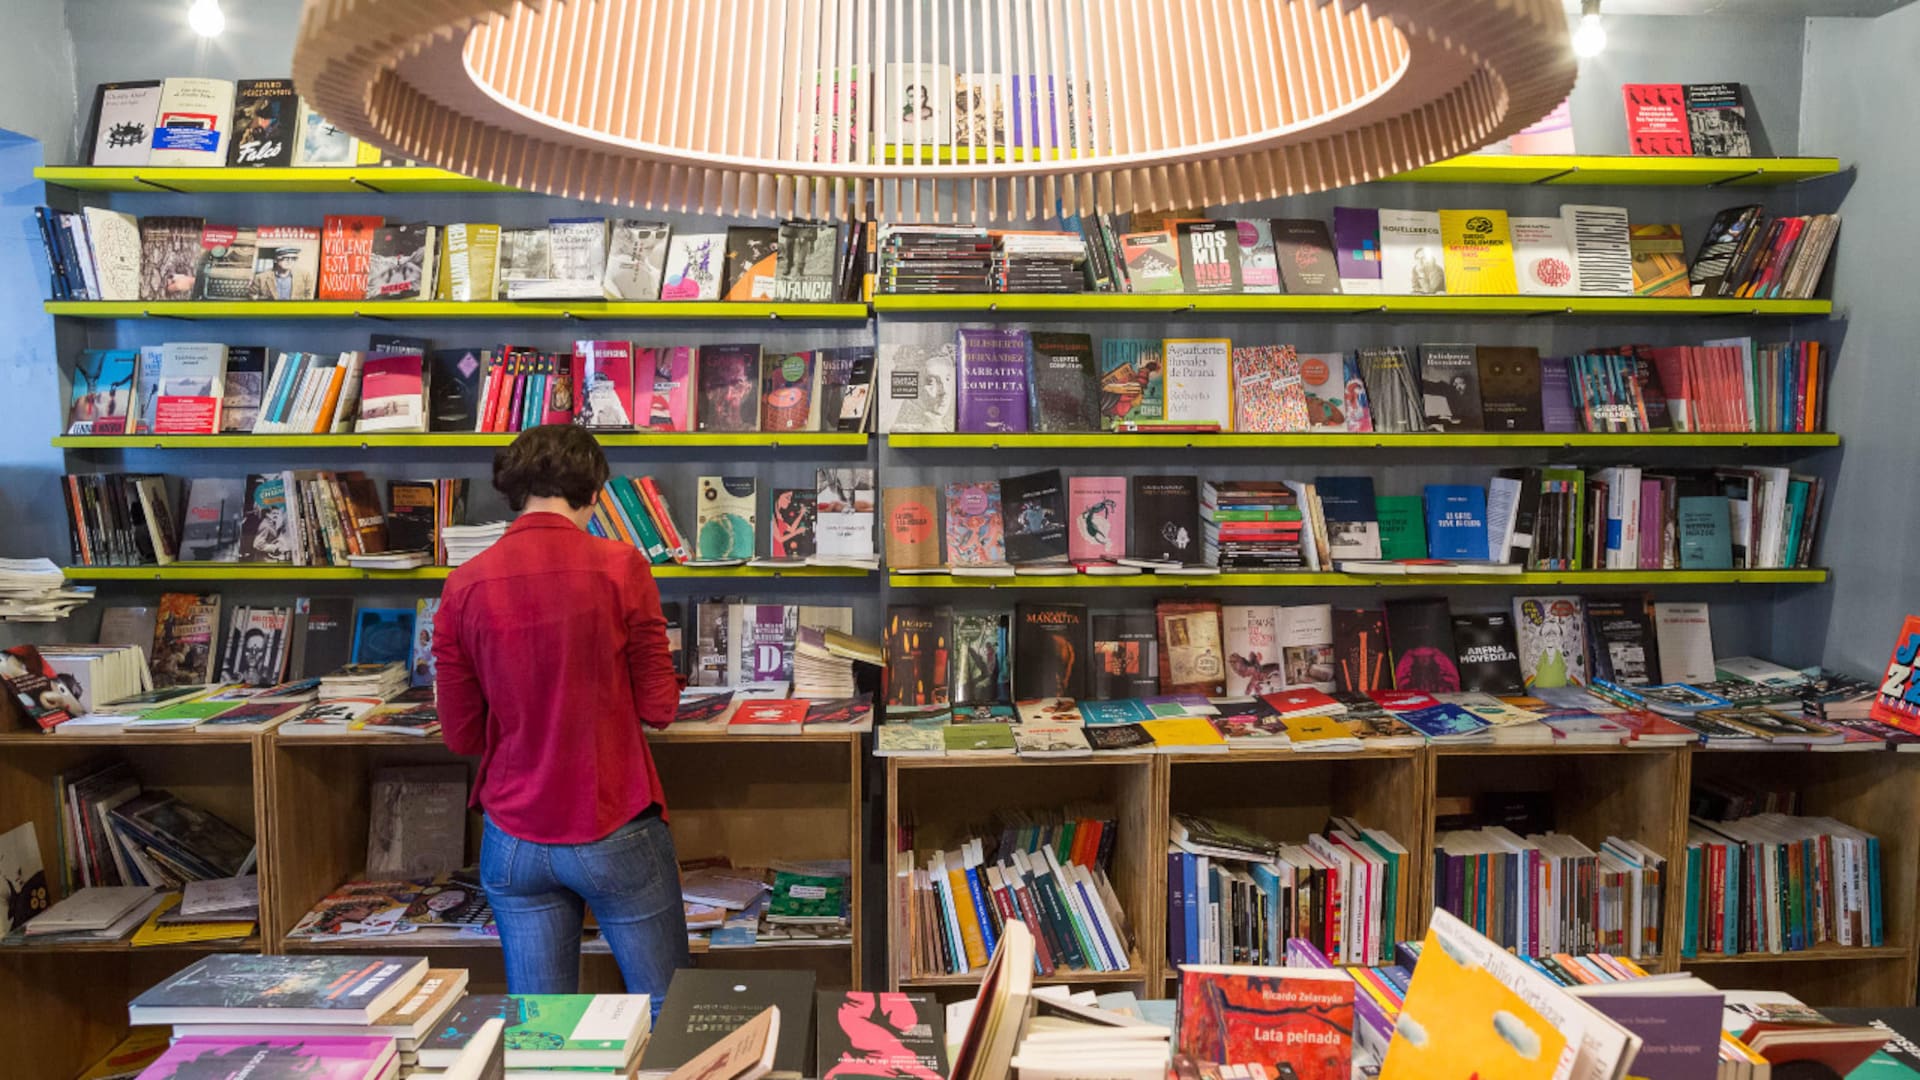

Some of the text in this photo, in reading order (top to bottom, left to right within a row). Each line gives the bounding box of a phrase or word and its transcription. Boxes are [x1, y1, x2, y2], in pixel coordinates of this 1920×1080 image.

[1190, 231, 1227, 249] DOS
[1193, 247, 1229, 264] MIL
[1459, 651, 1517, 664] MOVEDIZA
[1467, 645, 1504, 656] ARENA
[1262, 990, 1343, 1005] Ricardo Zelarayán
[1254, 1027, 1341, 1045] Lata peinada
